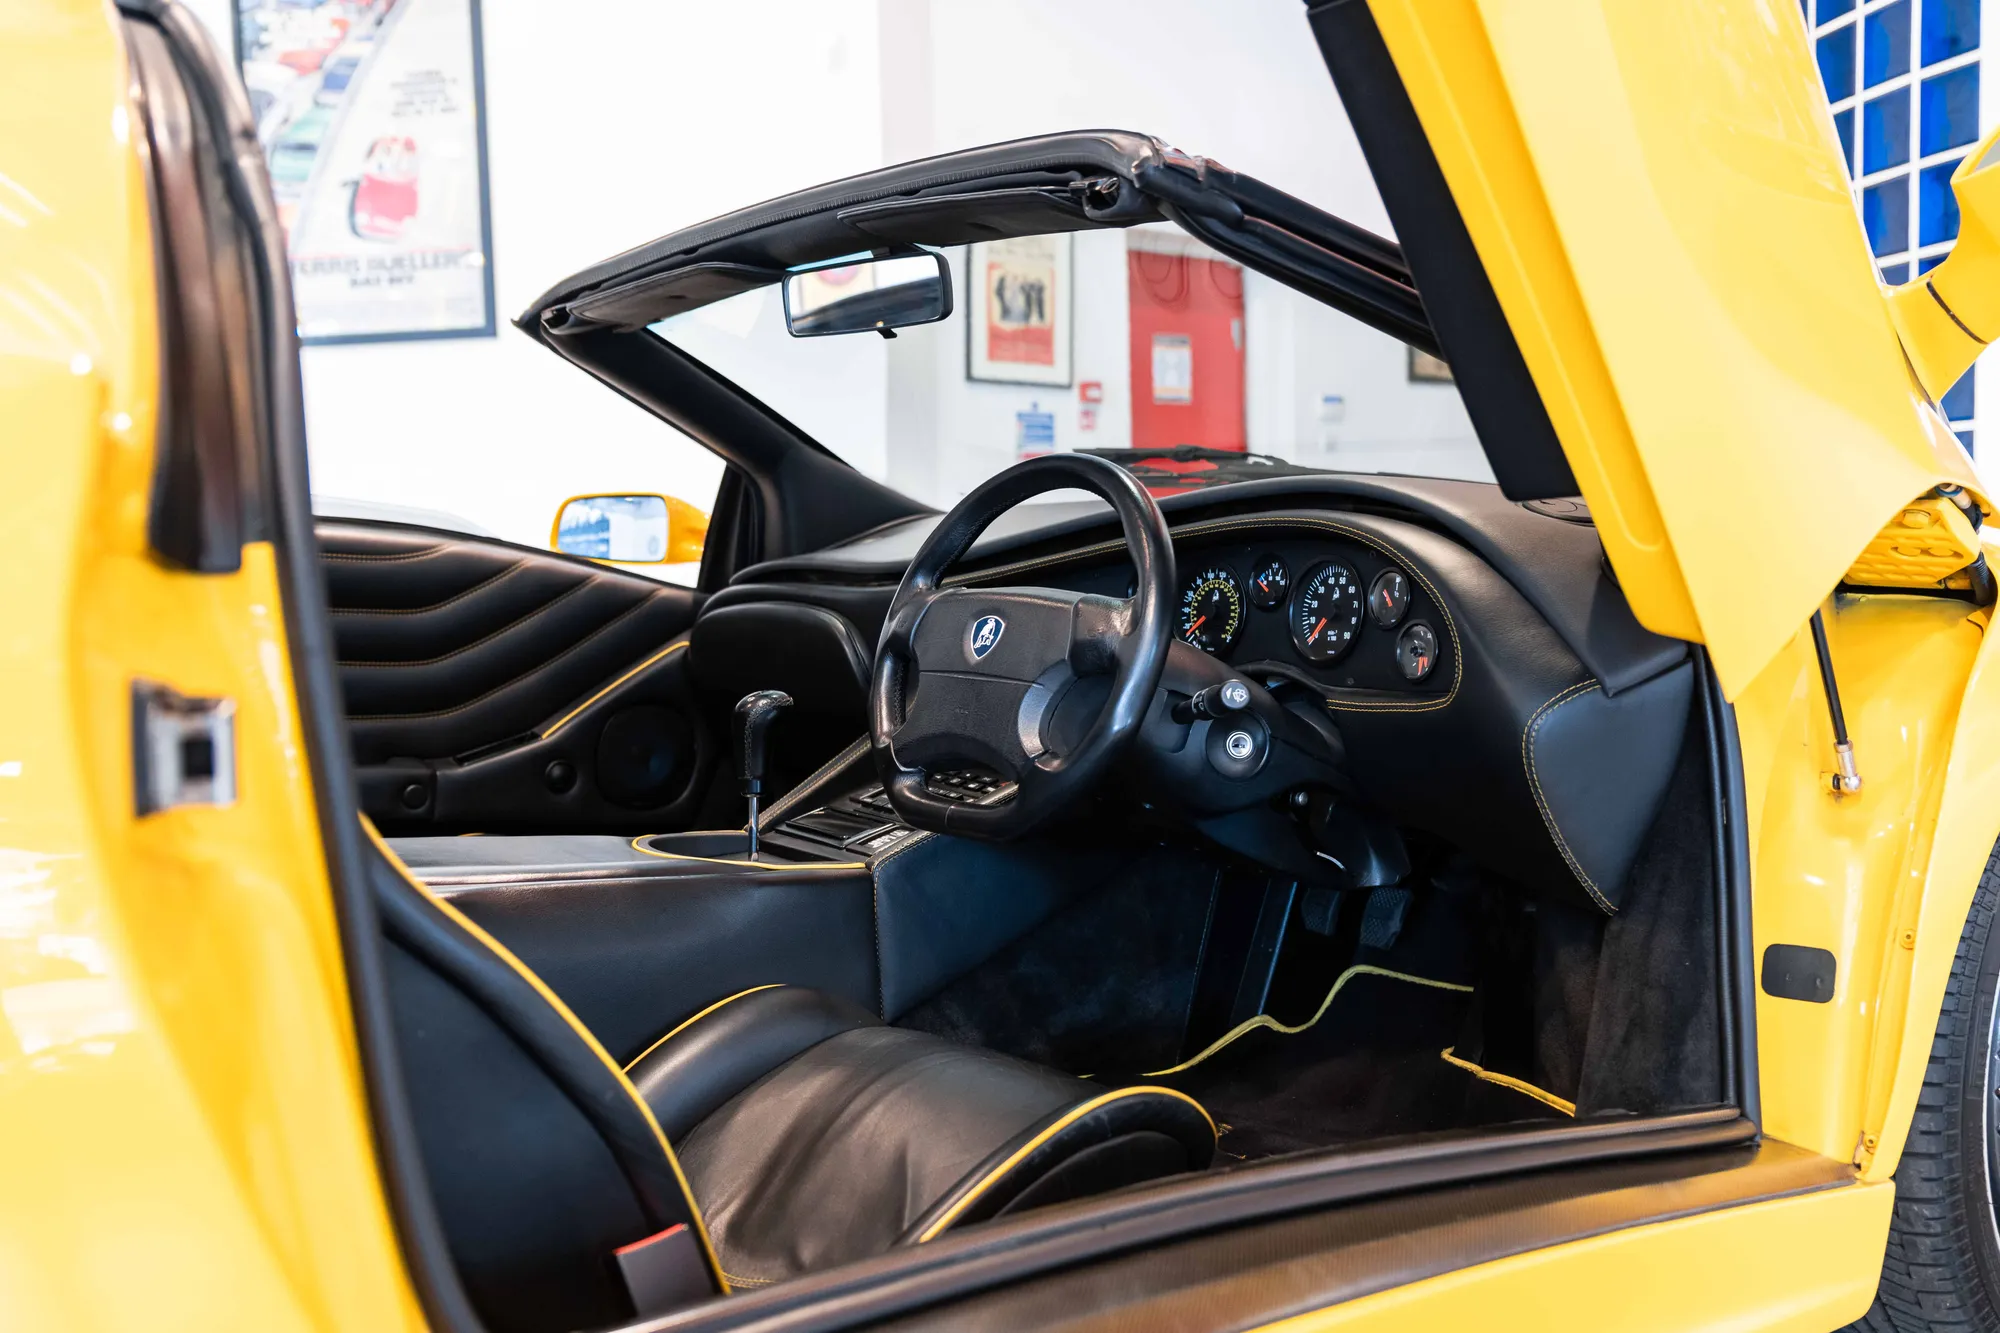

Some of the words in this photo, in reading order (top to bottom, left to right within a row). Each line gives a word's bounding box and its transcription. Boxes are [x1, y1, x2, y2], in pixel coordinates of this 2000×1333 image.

[1318, 586, 1325, 594] 30
[1348, 586, 1356, 594] 60
[1311, 600, 1318, 608] 20
[1309, 616, 1316, 624] 10
[1344, 631, 1351, 640] 90
